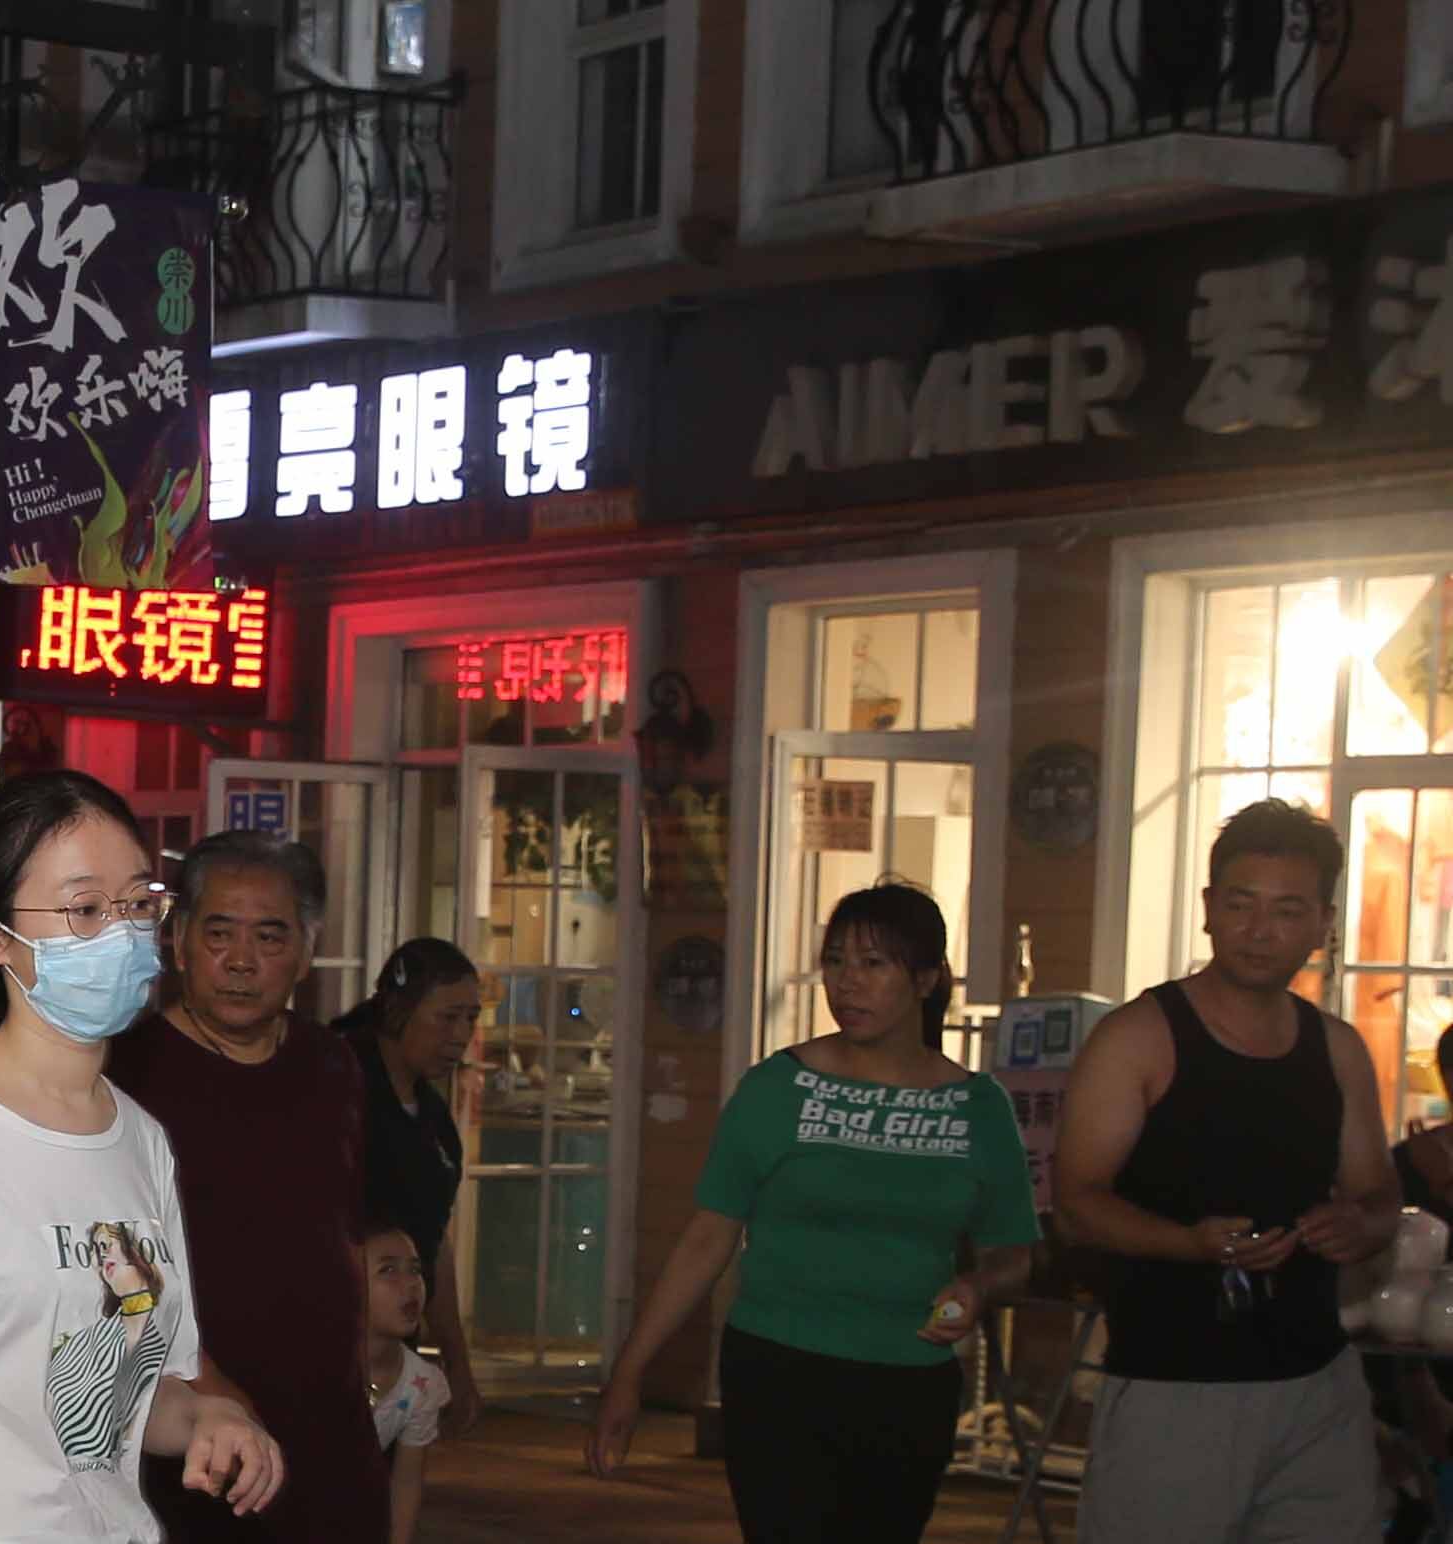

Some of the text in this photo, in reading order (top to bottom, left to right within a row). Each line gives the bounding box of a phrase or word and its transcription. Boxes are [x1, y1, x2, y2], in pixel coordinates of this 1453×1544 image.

[161, 249, 192, 331] 崇川
[4, 346, 190, 441] 欢乐嗨
[753, 324, 1143, 478] AIMER
[8, 484, 58, 508] Happy
[12, 487, 103, 525] Chongchuan
[797, 1123, 972, 1152] go backstage
[800, 1098, 970, 1137] Bad Girls
[50, 1220, 174, 1270] For You
